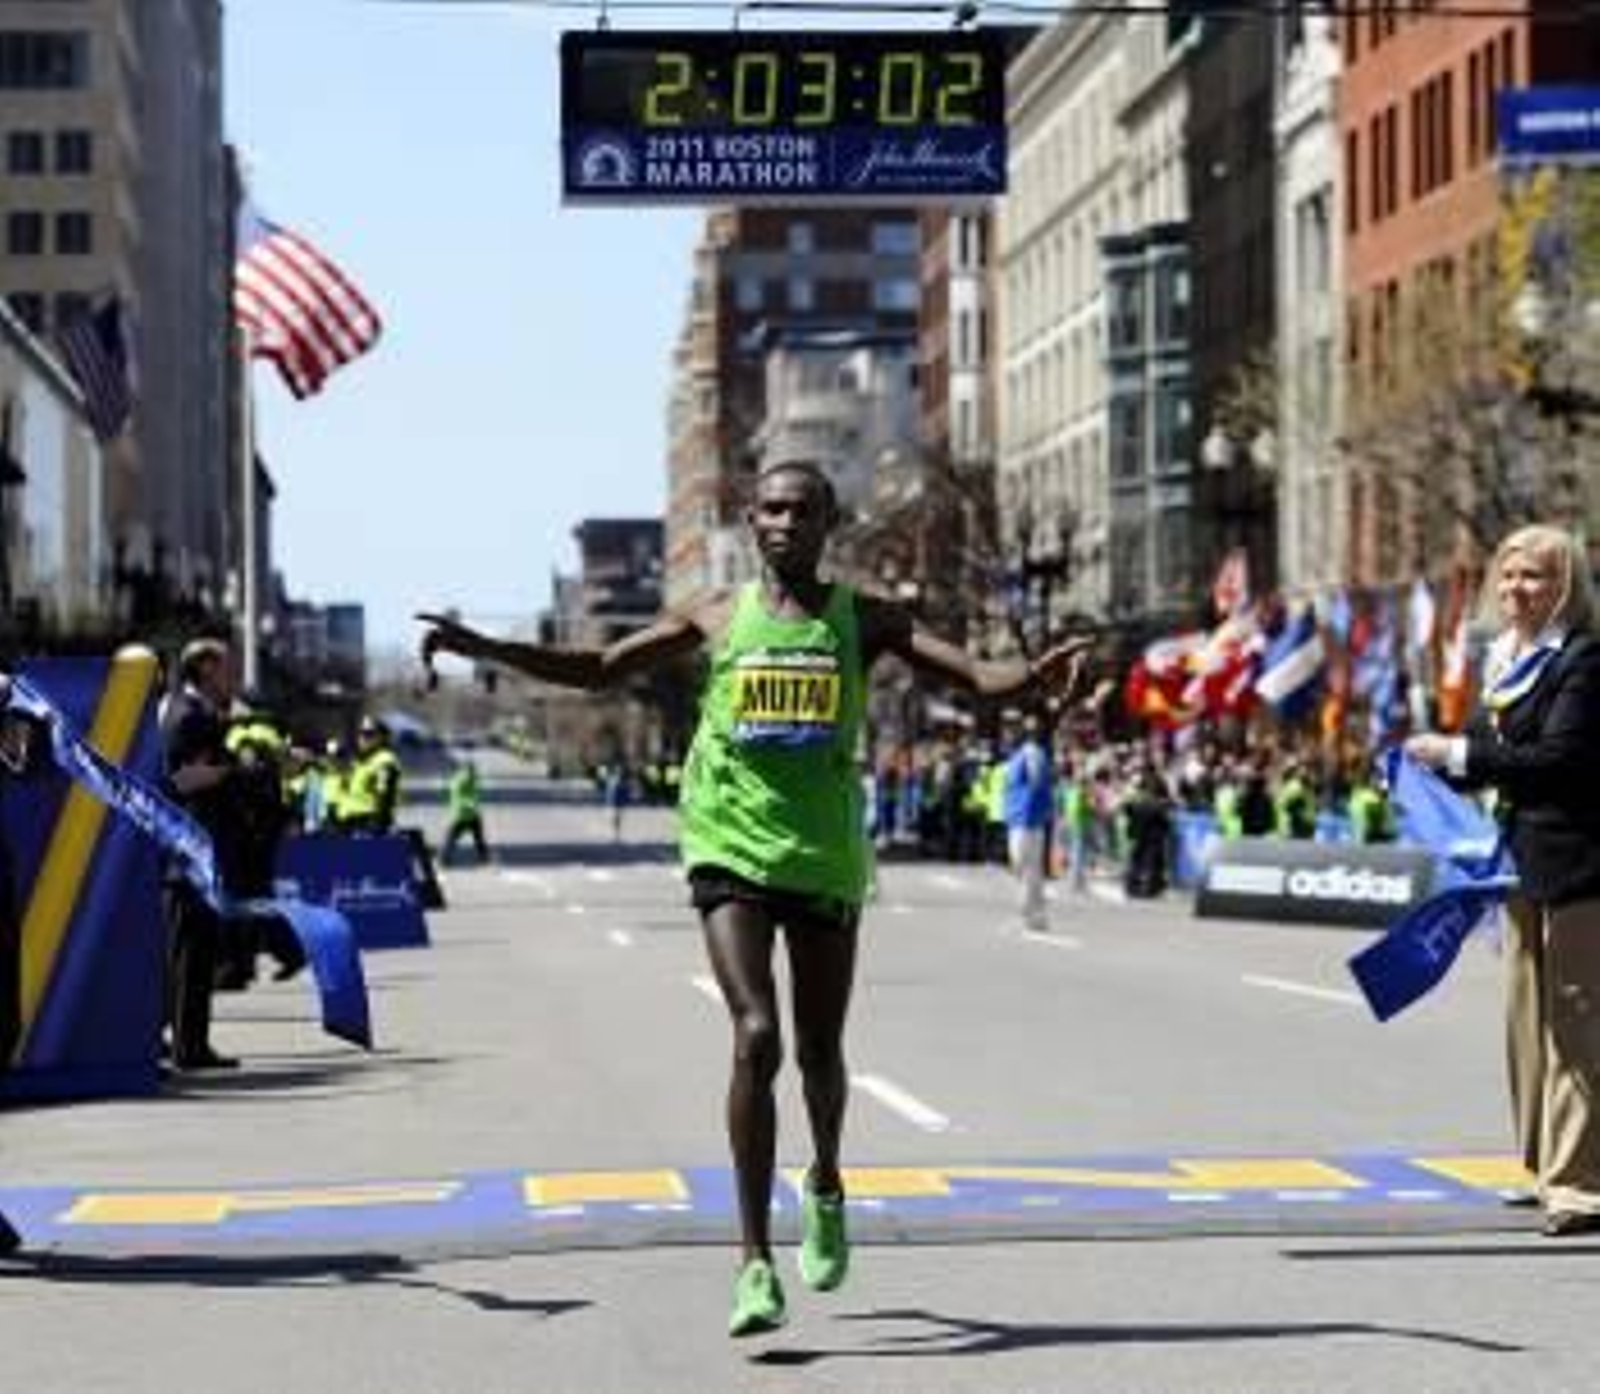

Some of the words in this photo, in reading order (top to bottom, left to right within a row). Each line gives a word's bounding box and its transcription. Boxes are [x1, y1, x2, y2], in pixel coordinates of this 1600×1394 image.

[643, 52, 983, 126] 2:03:02
[646, 137, 704, 160] 2011
[714, 136, 815, 160] BOSTON
[645, 161, 817, 186] MARATHON
[743, 677, 832, 713] MUTAI
[1289, 867, 1411, 902] adidas
